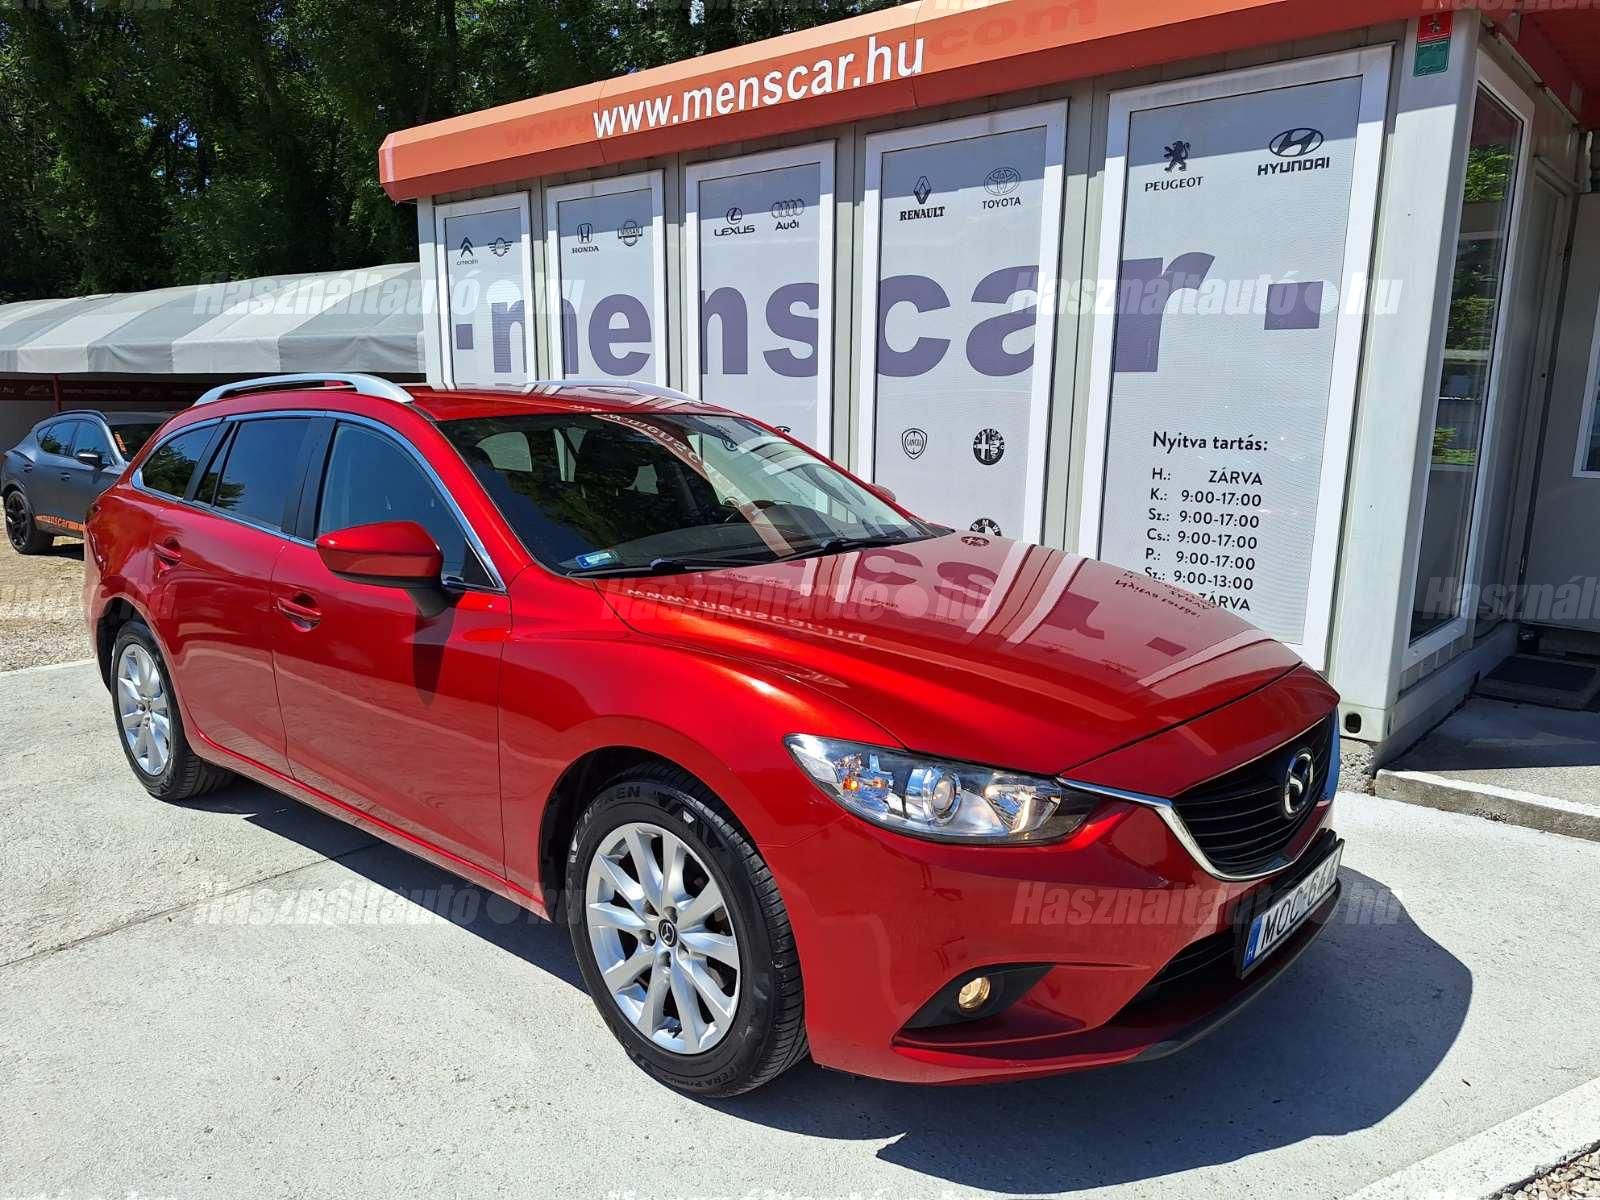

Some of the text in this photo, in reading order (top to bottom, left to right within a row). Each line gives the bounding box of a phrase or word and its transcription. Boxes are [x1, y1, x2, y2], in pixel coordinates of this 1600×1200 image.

[593, 35, 924, 138] www.menscar.hu
[1257, 157, 1330, 176] HYUNDAI
[1144, 176, 1204, 192] PEUGEOT
[982, 197, 1022, 210] TOYOTA
[900, 206, 945, 221] RENAULT
[714, 225, 756, 237] LEXUS
[775, 220, 800, 231] Audi
[572, 245, 600, 254] HONDA
[1153, 431, 1268, 454] Nyitva tartás:
[1152, 467, 1263, 486] H.: ZÁRVA
[1150, 488, 1262, 507] K.: 9:00-17:00
[1148, 508, 1260, 529] Sz.: 9:00-17:00
[1147, 528, 1258, 549] Cs.: 9:00-17:00
[1145, 548, 1256, 570] P.: 9:00-17:00
[1174, 570, 1254, 591] 9:00-13:00
